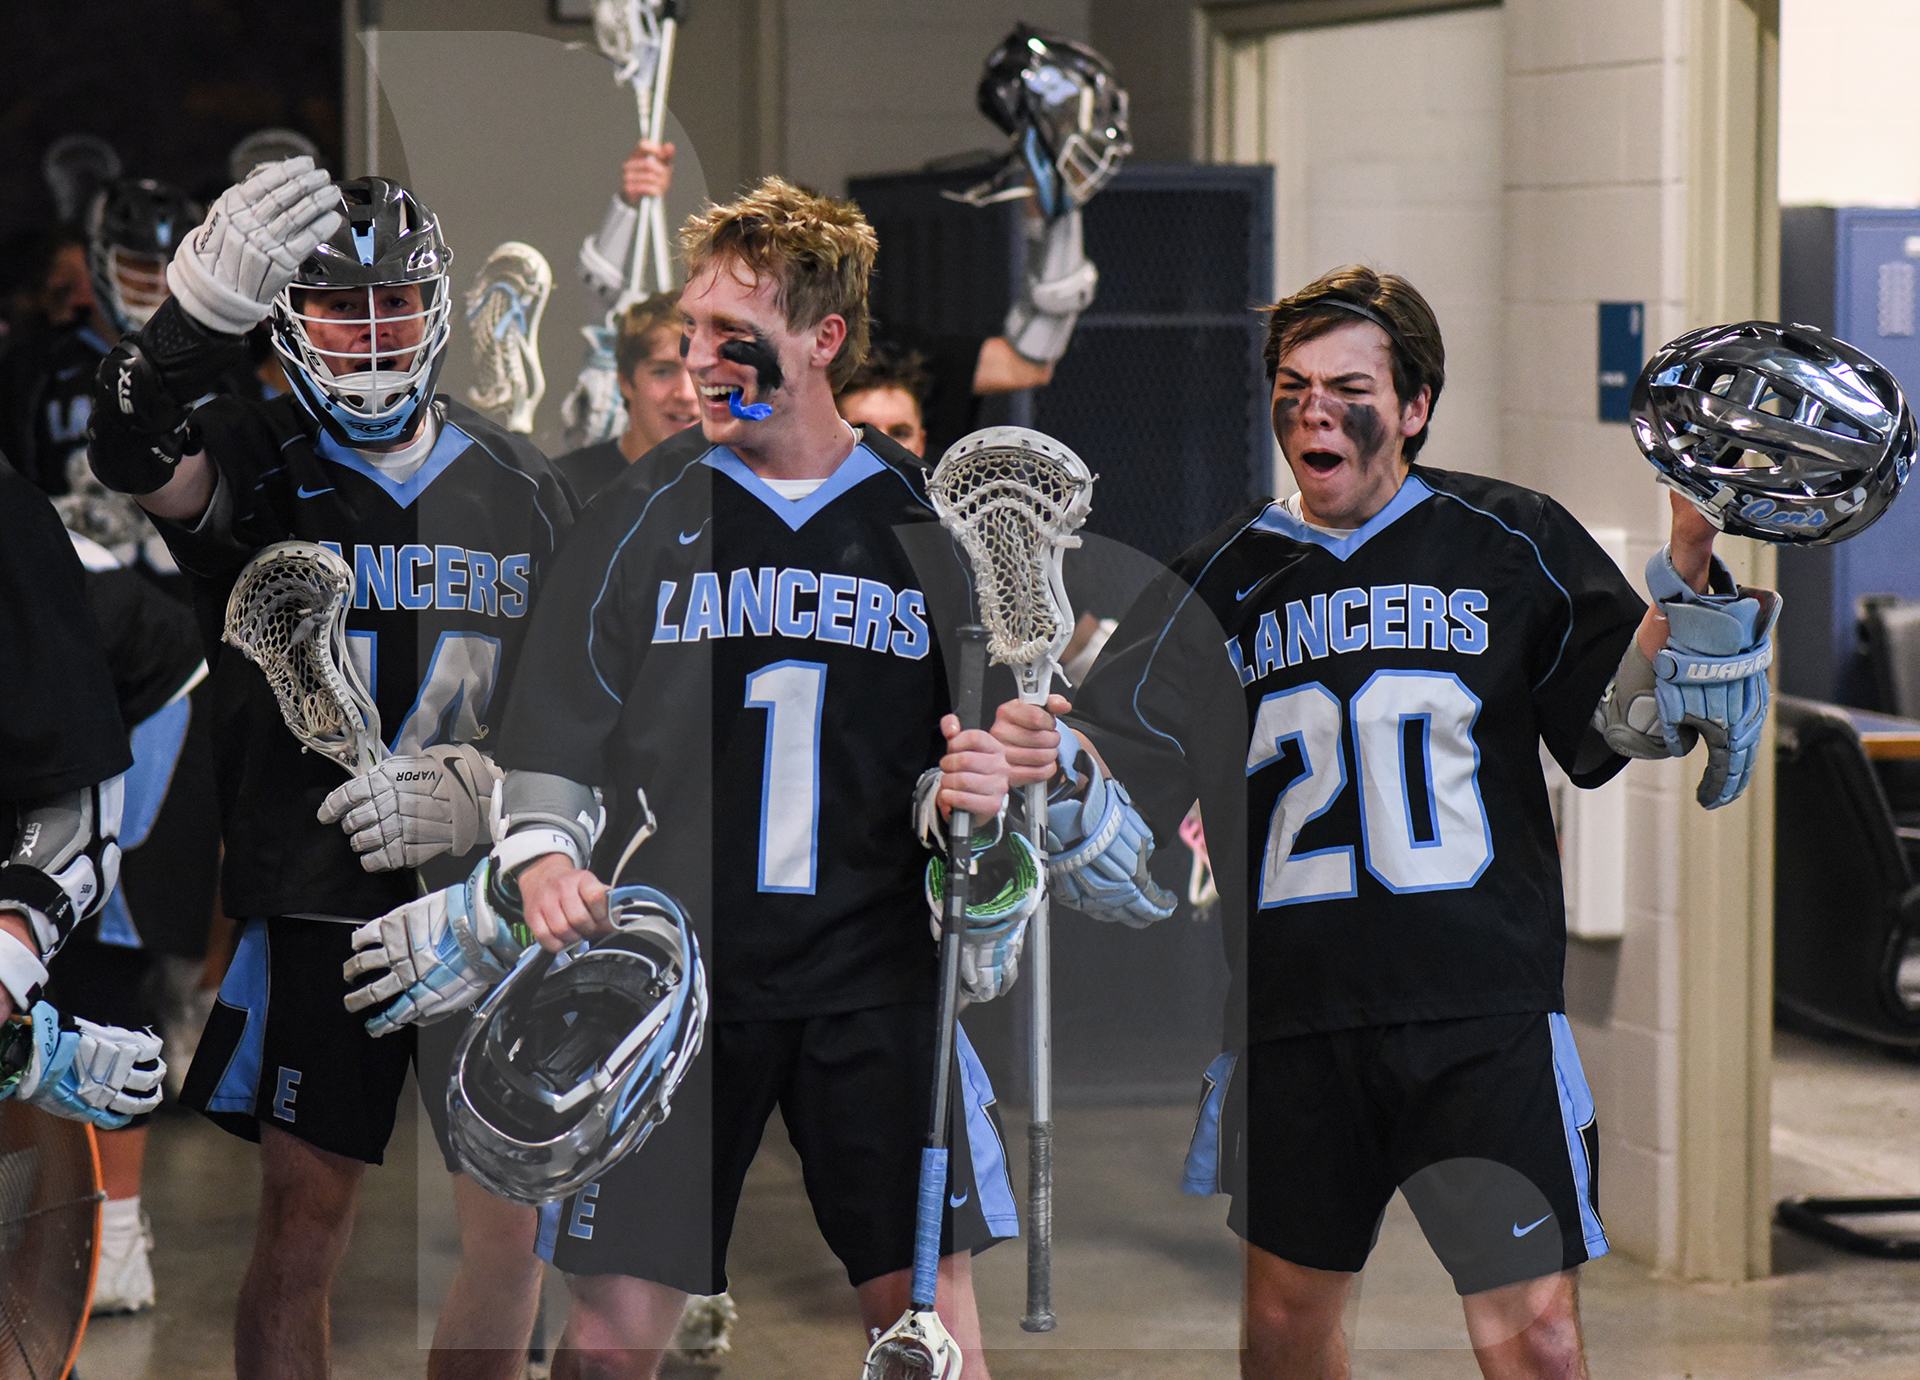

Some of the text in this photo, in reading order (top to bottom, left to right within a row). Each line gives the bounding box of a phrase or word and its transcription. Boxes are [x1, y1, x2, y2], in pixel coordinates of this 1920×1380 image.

[117, 366, 135, 415] STX
[318, 540, 531, 619] NCERS
[651, 567, 930, 661] LANCERS
[1224, 583, 1490, 688] LANCERS
[395, 770, 436, 782] VAPOR
[743, 658, 828, 896] 1
[1245, 668, 1495, 913] 20
[18, 822, 42, 858] STX
[272, 1065, 302, 1124] E
[567, 1181, 600, 1240] E
